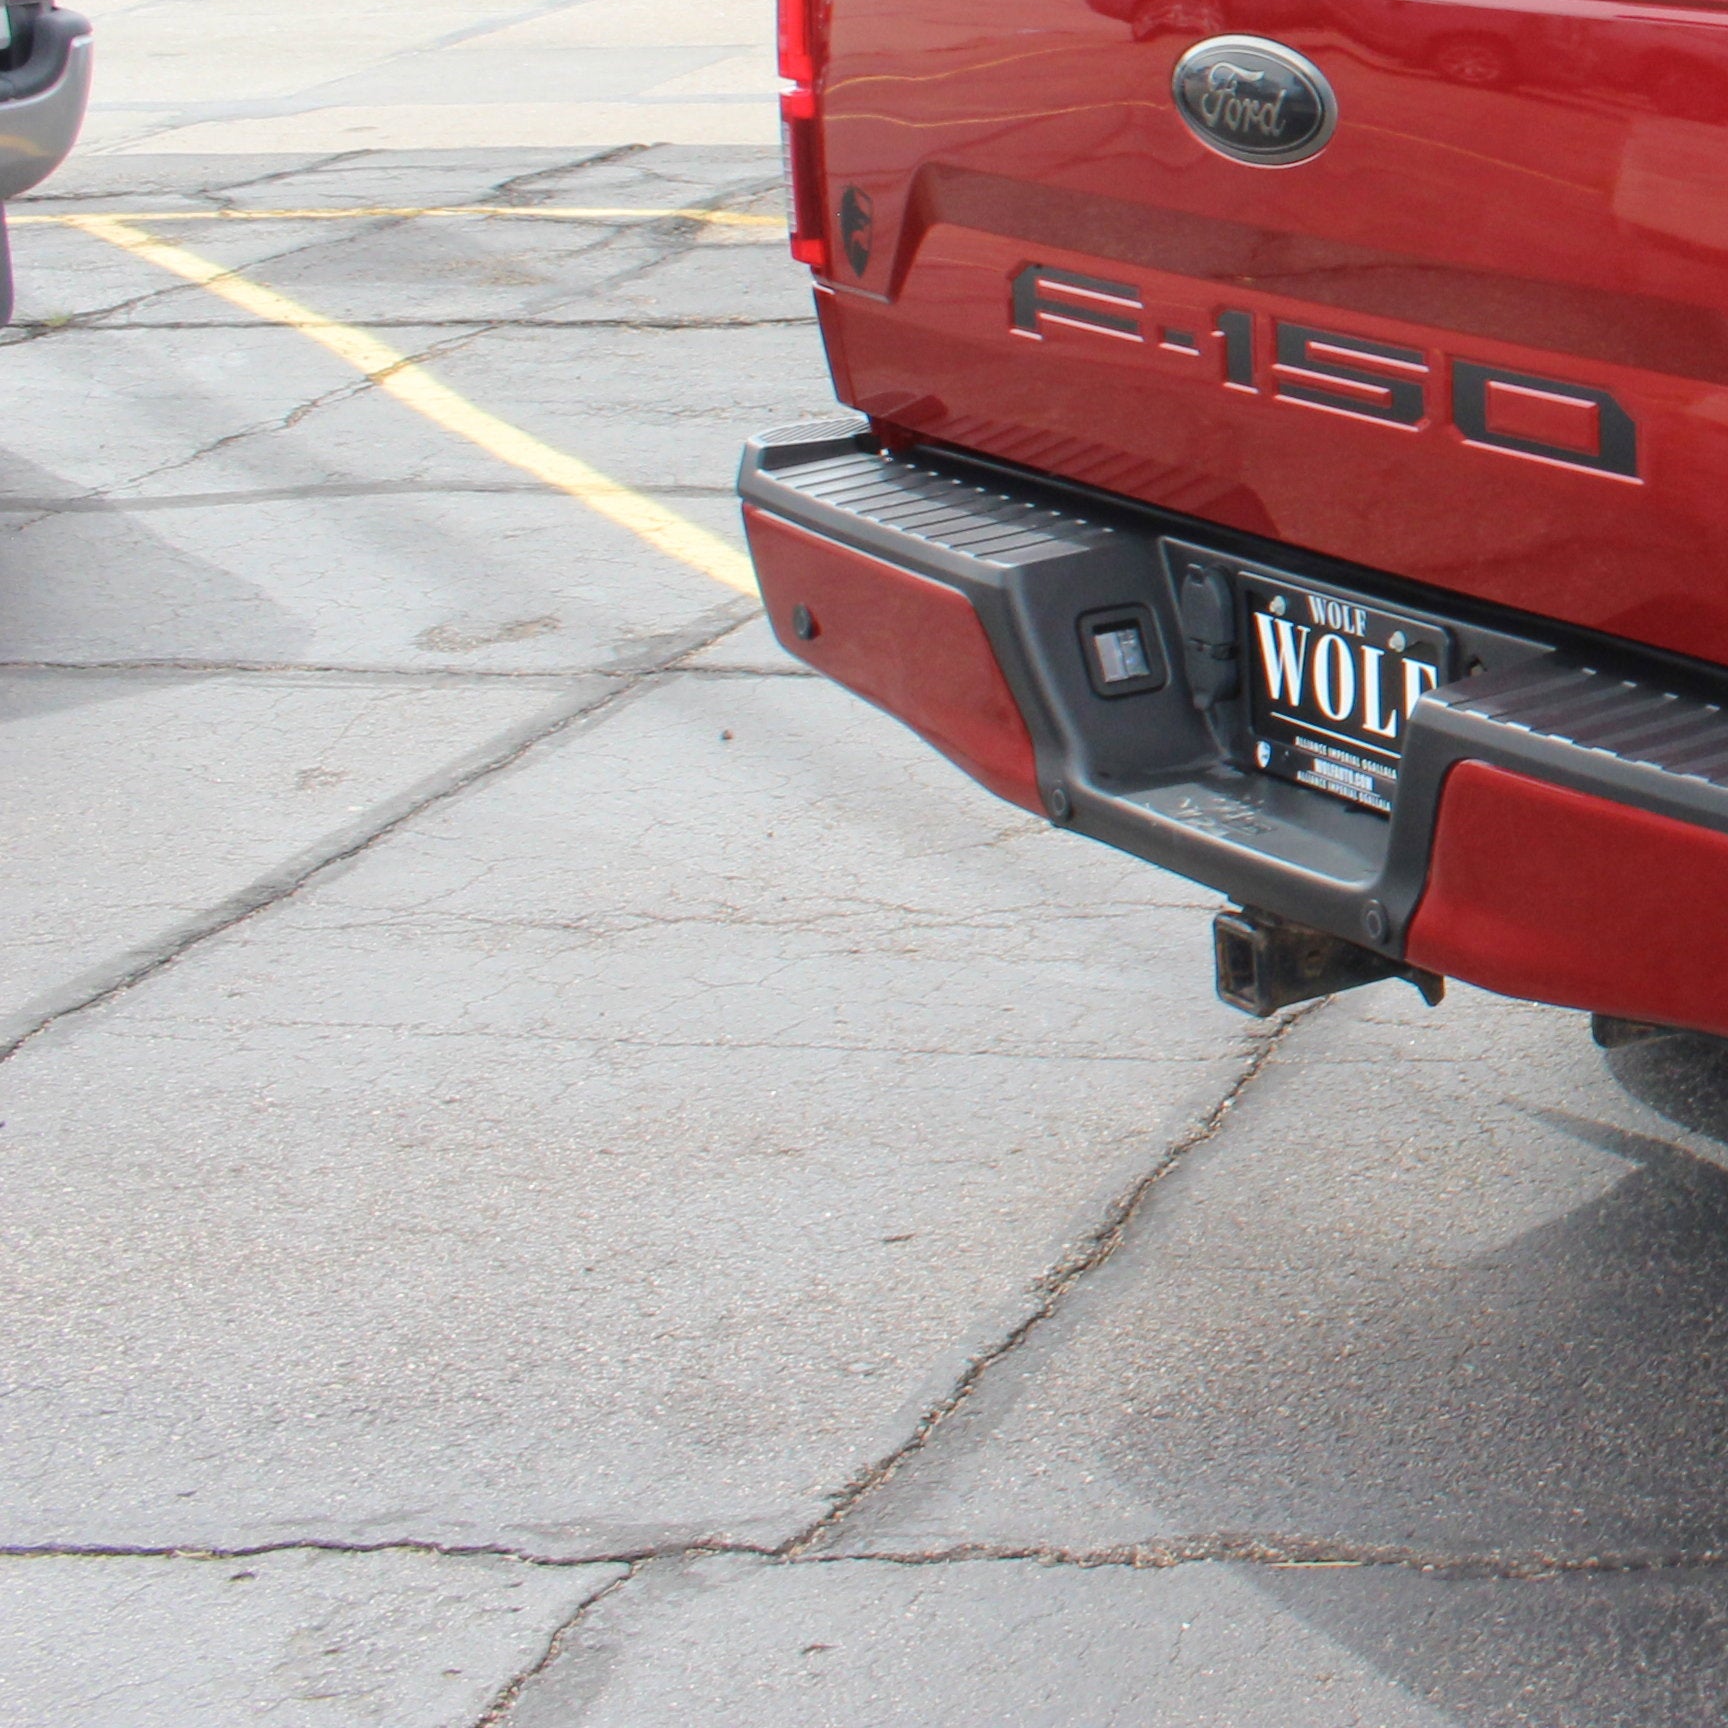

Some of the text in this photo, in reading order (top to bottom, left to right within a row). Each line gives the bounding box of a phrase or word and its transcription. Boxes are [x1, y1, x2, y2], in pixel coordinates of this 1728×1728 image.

[1202, 61, 1287, 137] Ford
[1010, 264, 1644, 485] F-150
[1308, 595, 1367, 638] WOLF
[1254, 612, 1438, 739] WOLF
